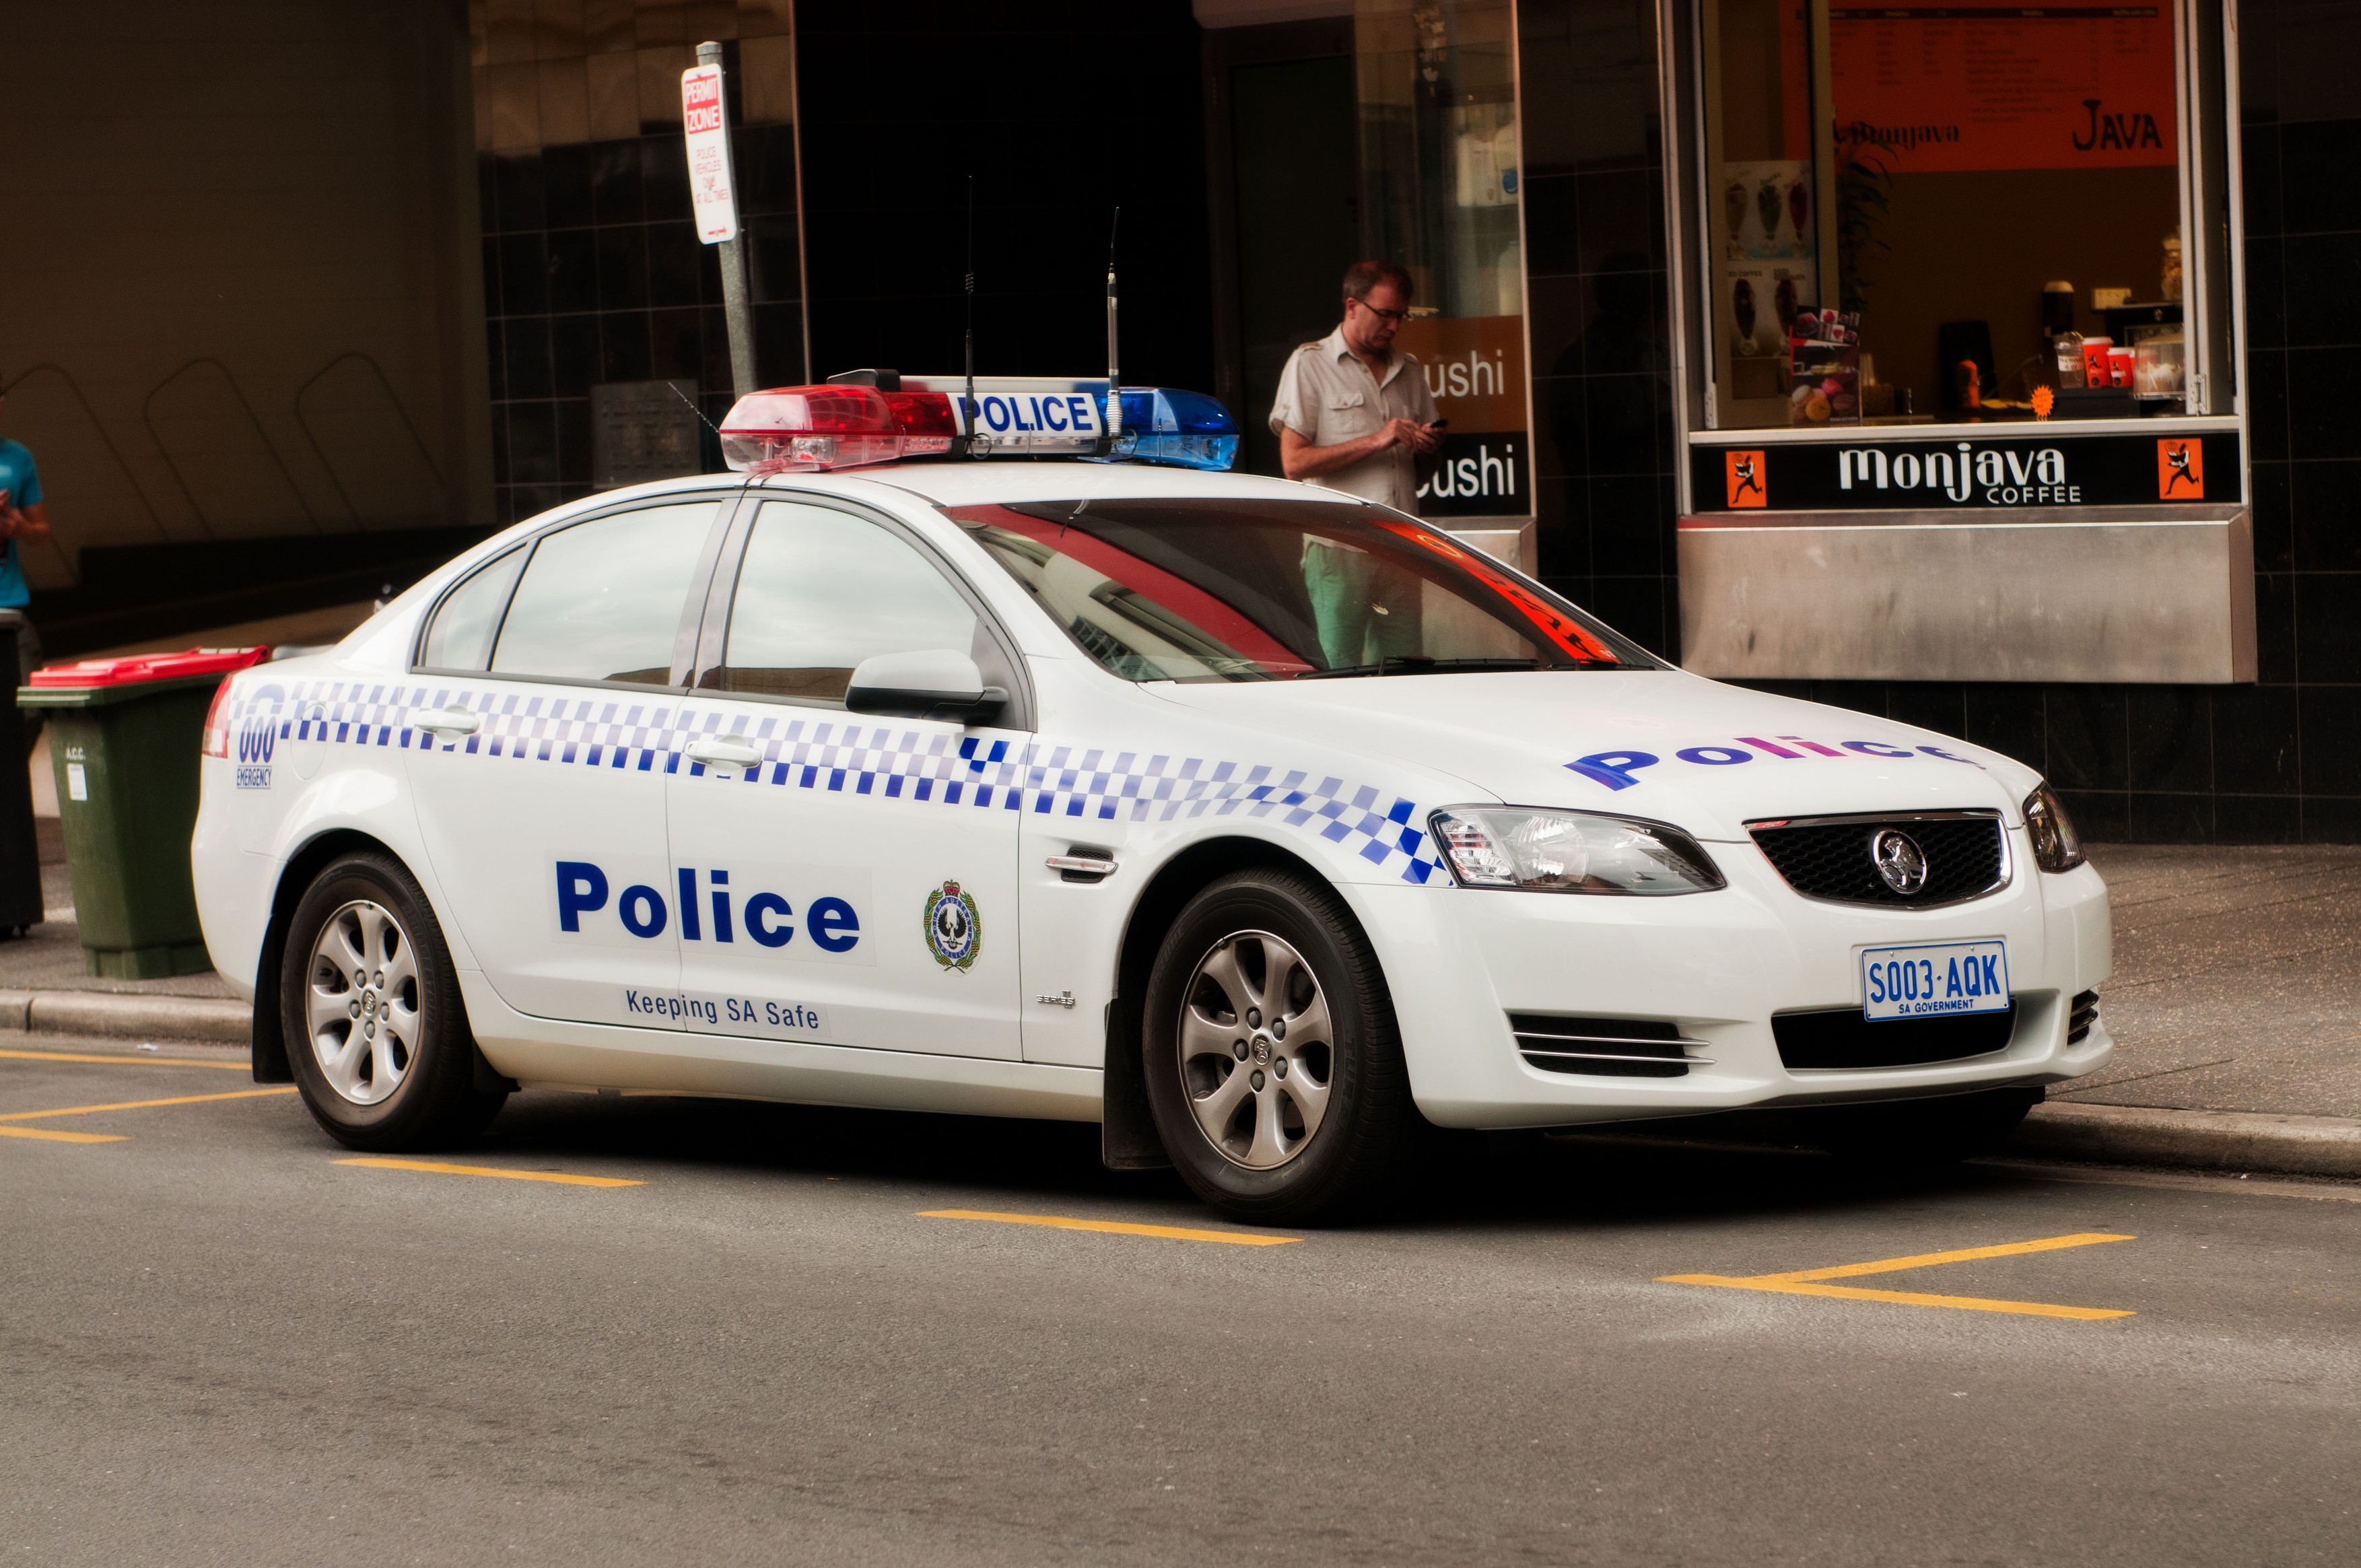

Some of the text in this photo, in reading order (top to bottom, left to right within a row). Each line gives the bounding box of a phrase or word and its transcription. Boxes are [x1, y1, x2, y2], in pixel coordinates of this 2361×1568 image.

[687, 79, 718, 104] PERMIT
[688, 106, 720, 131] ZONE
[2072, 99, 2163, 151] JAVA
[696, 146, 717, 160] POLICE
[1425, 349, 1504, 398] ushi
[957, 396, 1093, 432] POLICE
[1839, 442, 2065, 502] monjava
[1986, 485, 2082, 504] COFFEE
[237, 768, 272, 786] EMERGENCY
[1563, 736, 1987, 792] Police
[556, 861, 860, 953] Police
[945, 897, 971, 942] AUSTRALIA
[940, 946, 967, 959] POLICE
[626, 990, 819, 1029] Keeping SA Safe
[1035, 994, 1075, 1005] SERIES
[1898, 998, 1974, 1014] SA GOVERNMENT
